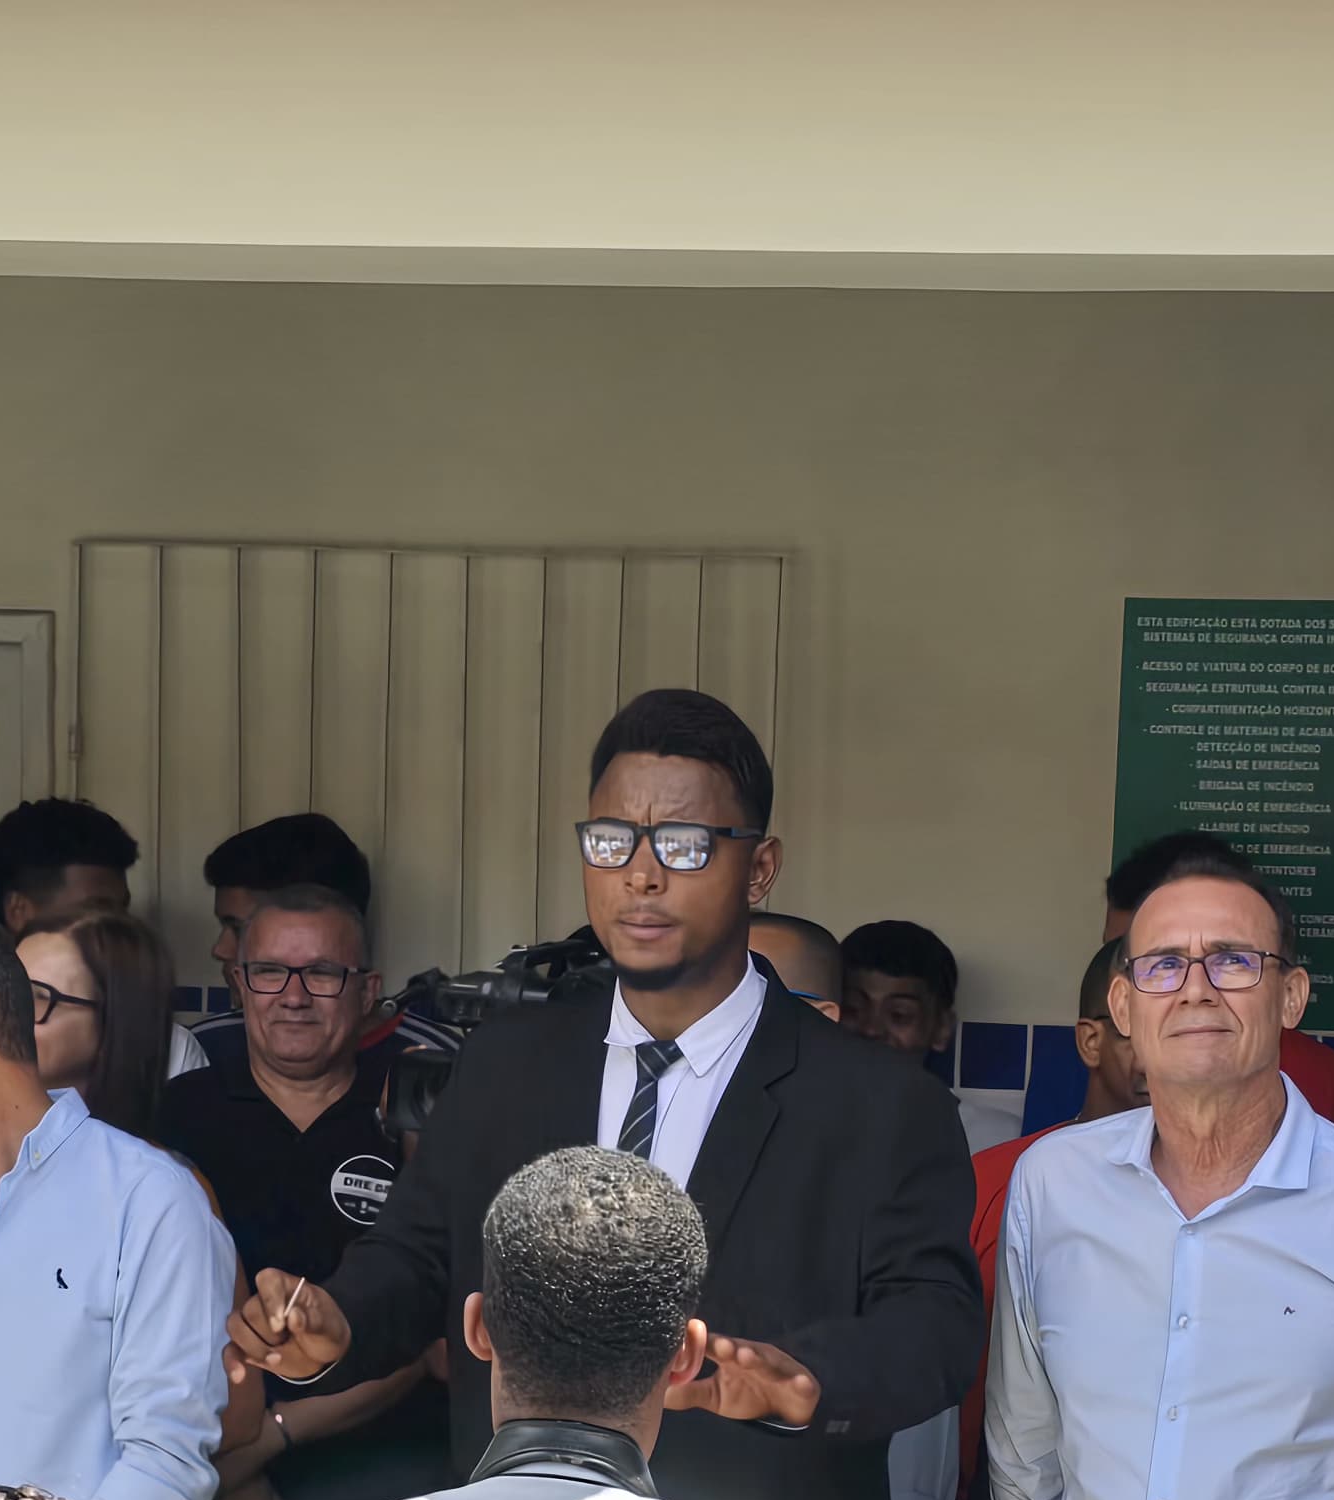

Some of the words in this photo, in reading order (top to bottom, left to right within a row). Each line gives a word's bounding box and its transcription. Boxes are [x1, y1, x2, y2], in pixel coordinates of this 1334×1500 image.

[1260, 619, 1302, 629] DOTADA
[1305, 619, 1326, 629] DOS
[1144, 632, 1195, 642] SISTEMAS
[1198, 632, 1211, 643] DE
[1214, 633, 1277, 645] SEGURANÇA
[1280, 634, 1323, 644] CONTRA
[1142, 661, 1183, 671] ACESSO
[1186, 662, 1200, 672] DE
[1202, 662, 1246, 672] VIATURA
[1249, 663, 1265, 673] DO
[1267, 663, 1303, 673] CORPO
[1306, 663, 1320, 674] DE
[1146, 682, 1208, 695] SEGURANÇA
[1211, 683, 1279, 694] ESTRUTURAL
[1282, 684, 1325, 695] CONTRA
[1171, 703, 1281, 717] COMPARTIMENTAÇÃO
[1149, 725, 1205, 735] CONTROLE
[1207, 725, 1221, 736] DE
[1223, 725, 1279, 736] MATERIAIS
[1281, 726, 1295, 737] DE
[1196, 741, 1251, 755] DETECÇÃO
[1254, 743, 1267, 753] DE
[1270, 741, 1322, 753] INCÊNDIO
[1235, 760, 1249, 770] DE
[1251, 759, 1320, 771] EMERGÊNCIA
[1198, 780, 1245, 791] BRIGADA
[1247, 781, 1260, 791] DE
[1263, 780, 1314, 792] INCÊNDIO
[1179, 800, 1244, 813] ILUMINAÇÃO
[1246, 802, 1260, 812] DE
[1263, 801, 1331, 813] EMERGÊNCIA
[1198, 822, 1240, 833] ALARME
[1243, 823, 1256, 833] DE
[1246, 844, 1260, 854] DE
